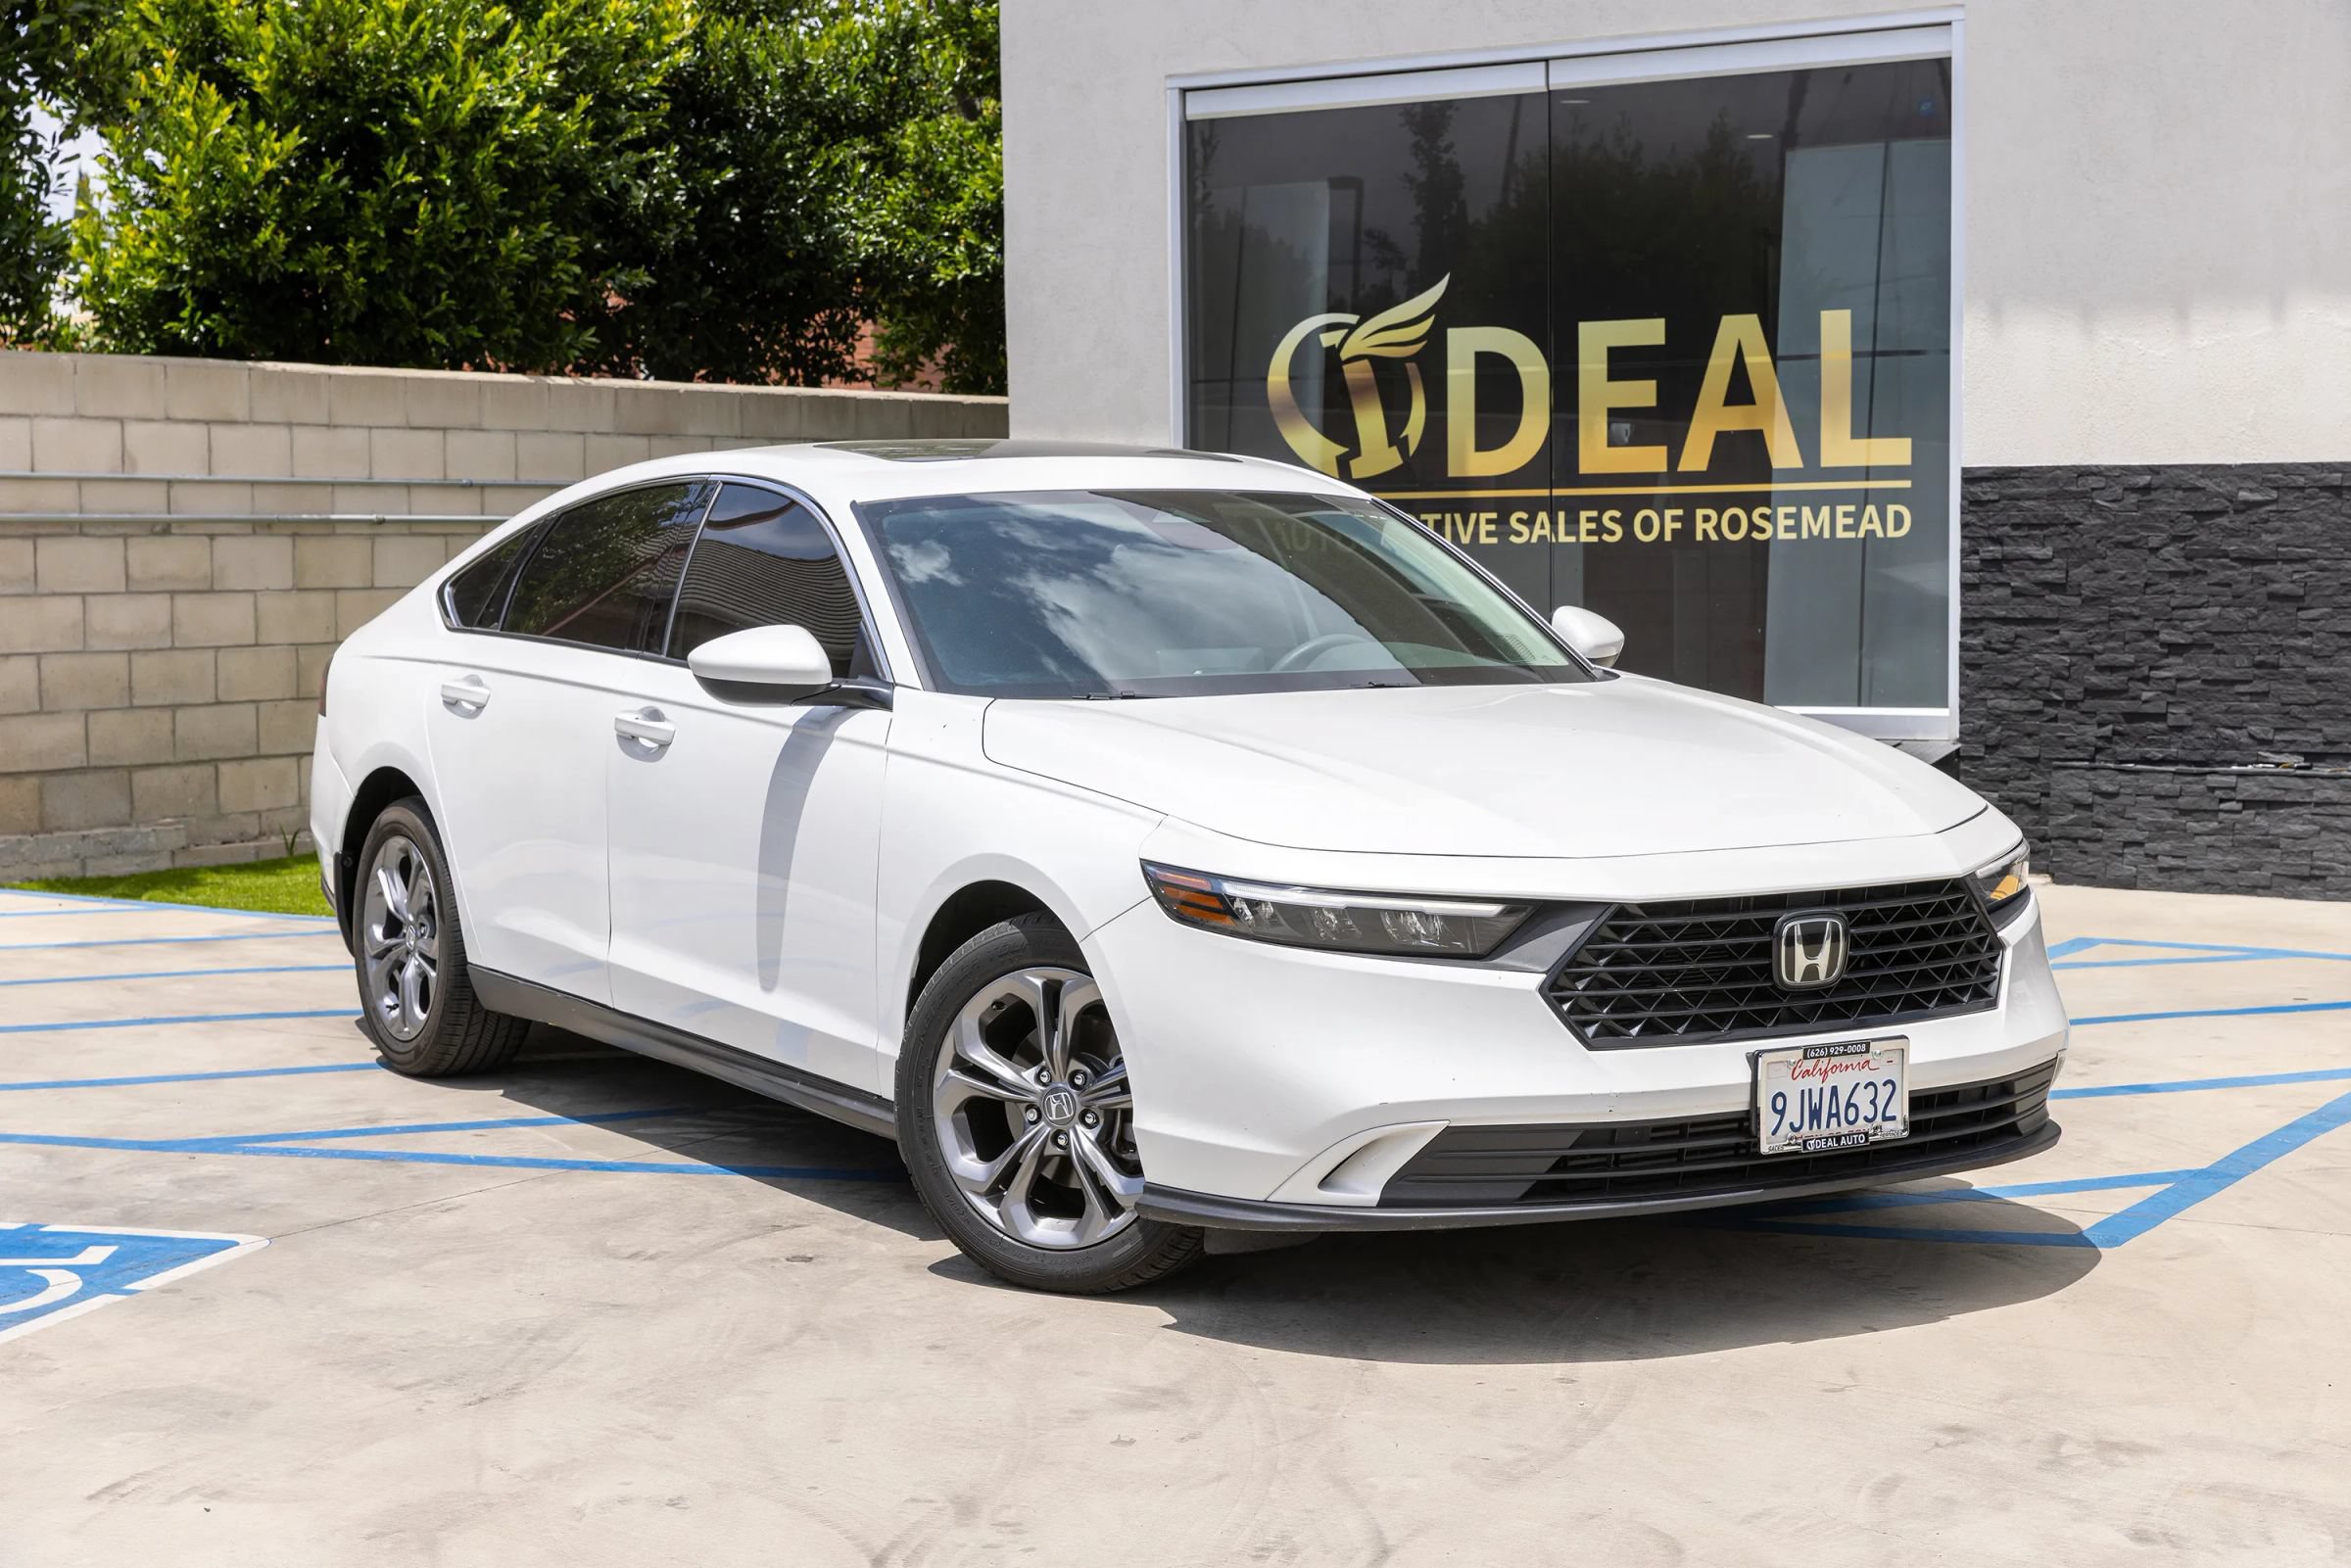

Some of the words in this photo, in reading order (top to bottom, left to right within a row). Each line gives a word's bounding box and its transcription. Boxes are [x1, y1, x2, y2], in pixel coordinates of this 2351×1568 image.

[1412, 511, 1499, 545] TIVE
[1509, 508, 1623, 544] SALES
[1632, 506, 1684, 543] OF
[1694, 503, 1912, 541] ROSEMEAD
[1806, 1047, 1828, 1058] (626)
[1829, 1044, 1866, 1057] 929-0008
[1791, 1058, 1880, 1084] California
[1771, 1078, 1897, 1137] 9JWA632
[1840, 1133, 1866, 1146] AUTO
